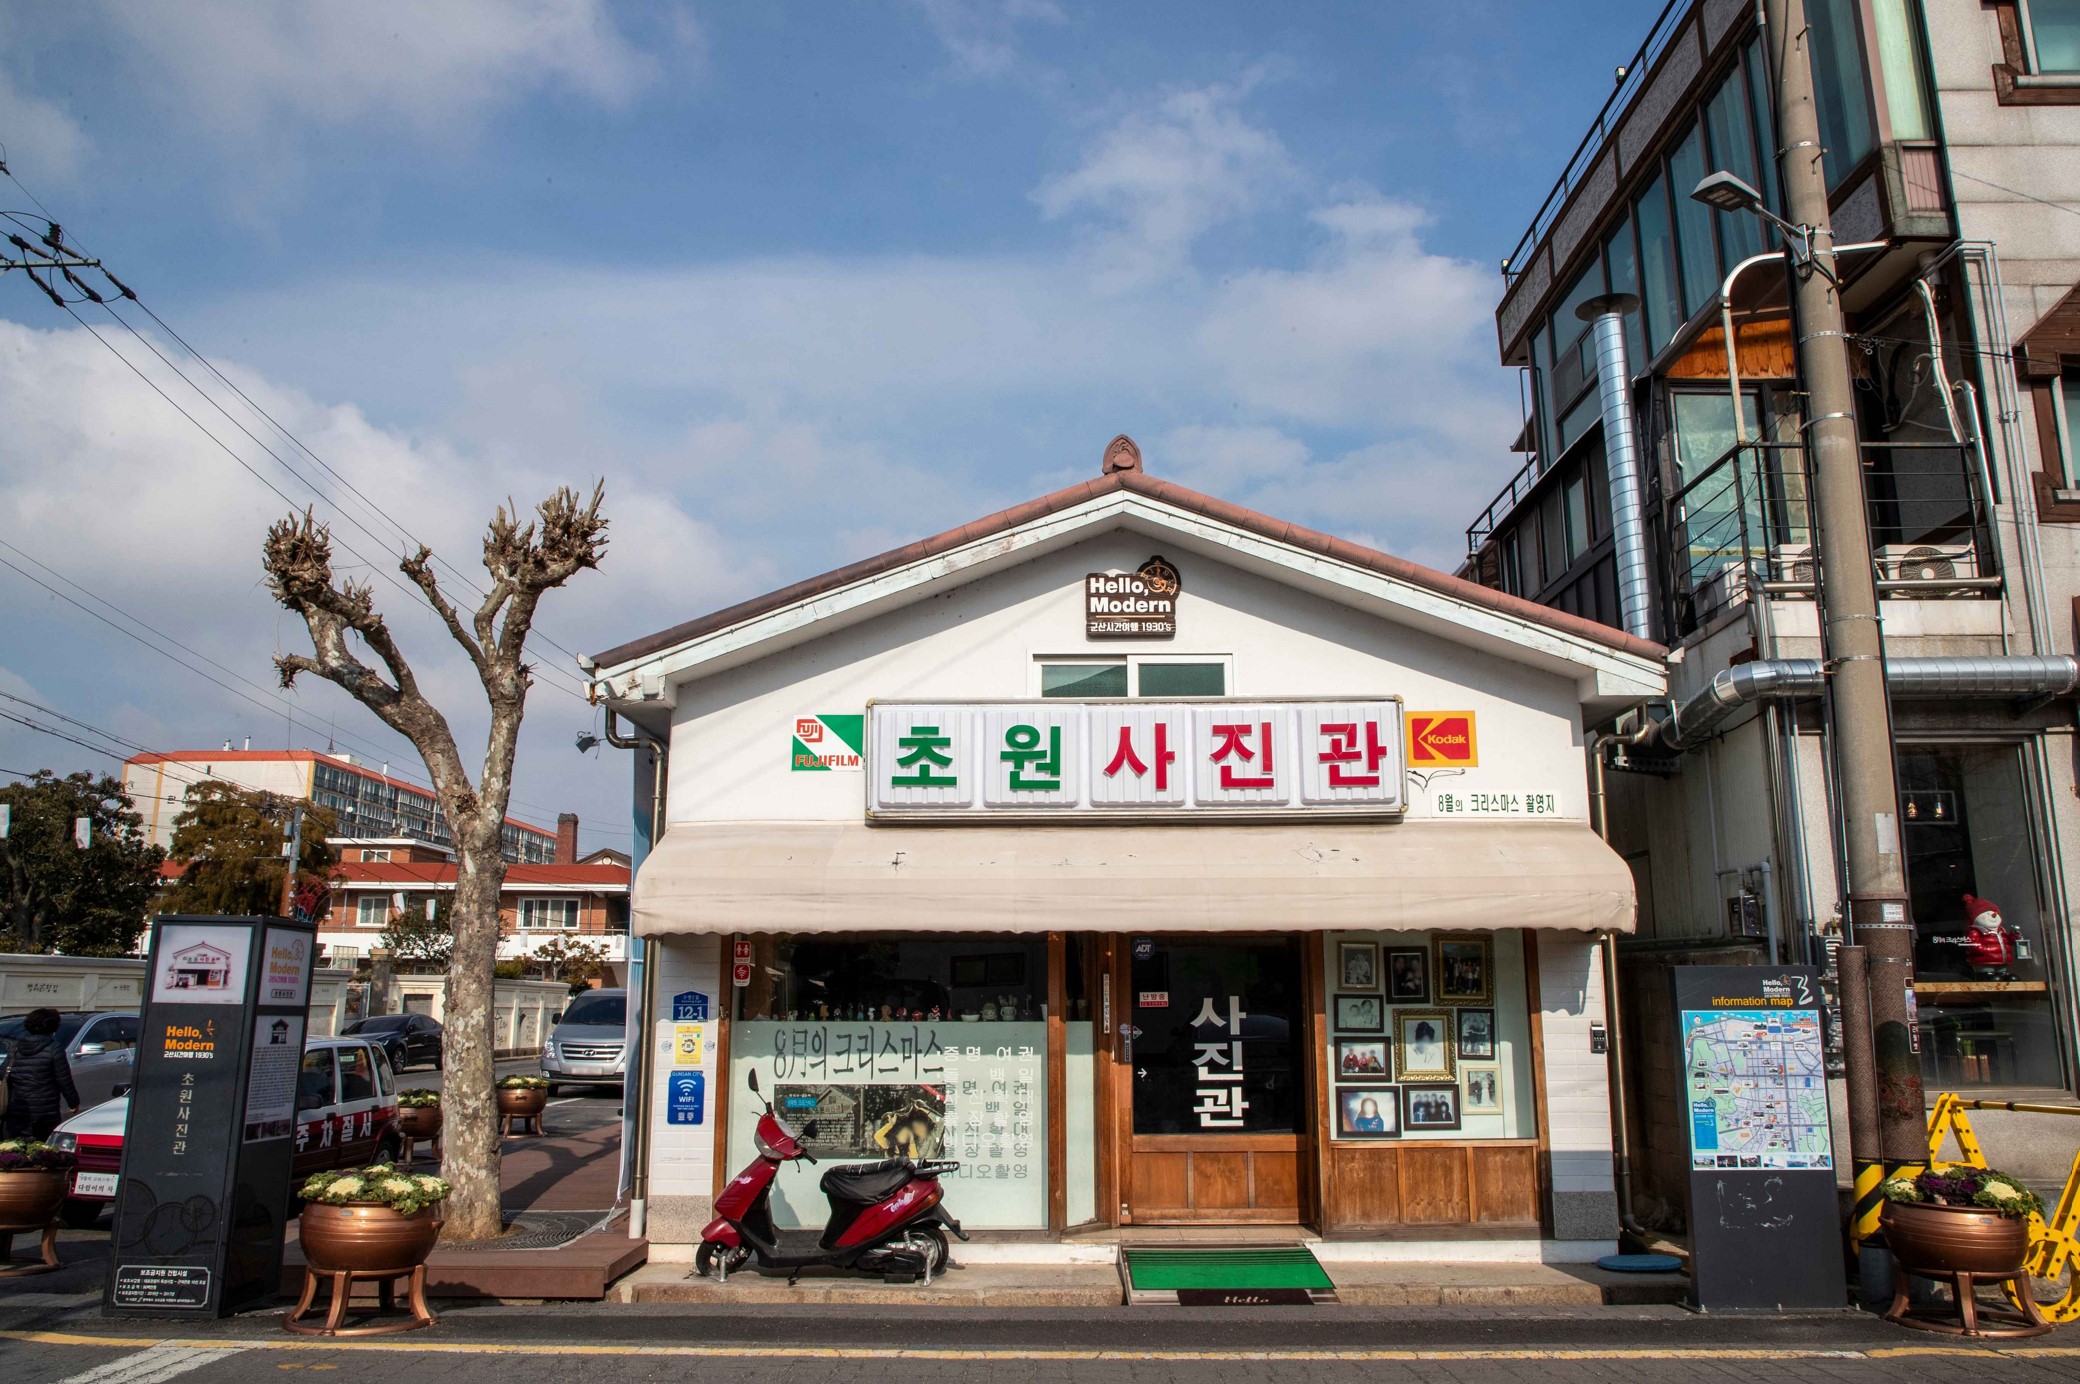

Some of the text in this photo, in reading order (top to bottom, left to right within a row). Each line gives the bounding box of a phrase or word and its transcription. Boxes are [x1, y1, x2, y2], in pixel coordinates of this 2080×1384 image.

[1090, 577, 1149, 596] Hello,
[1090, 597, 1171, 613] Modern
[1090, 622, 1172, 632] 군산시간여행 1930's
[1427, 735, 1466, 744] Kodak
[795, 755, 859, 767] FUJIFILM
[1438, 793, 1555, 814] 8월의 크리스마스 촬영지
[1136, 944, 1151, 953] ADT
[1762, 979, 1783, 987] Hello,
[1711, 996, 1794, 1008] information map
[678, 1006, 704, 1019] 12-1
[166, 1025, 202, 1040] Hello,
[164, 1039, 215, 1051] Modern
[832, 1025, 944, 1081] 크리스마스
[1189, 995, 1250, 1127] 사진관
[172, 1072, 195, 1155] 초원사진관
